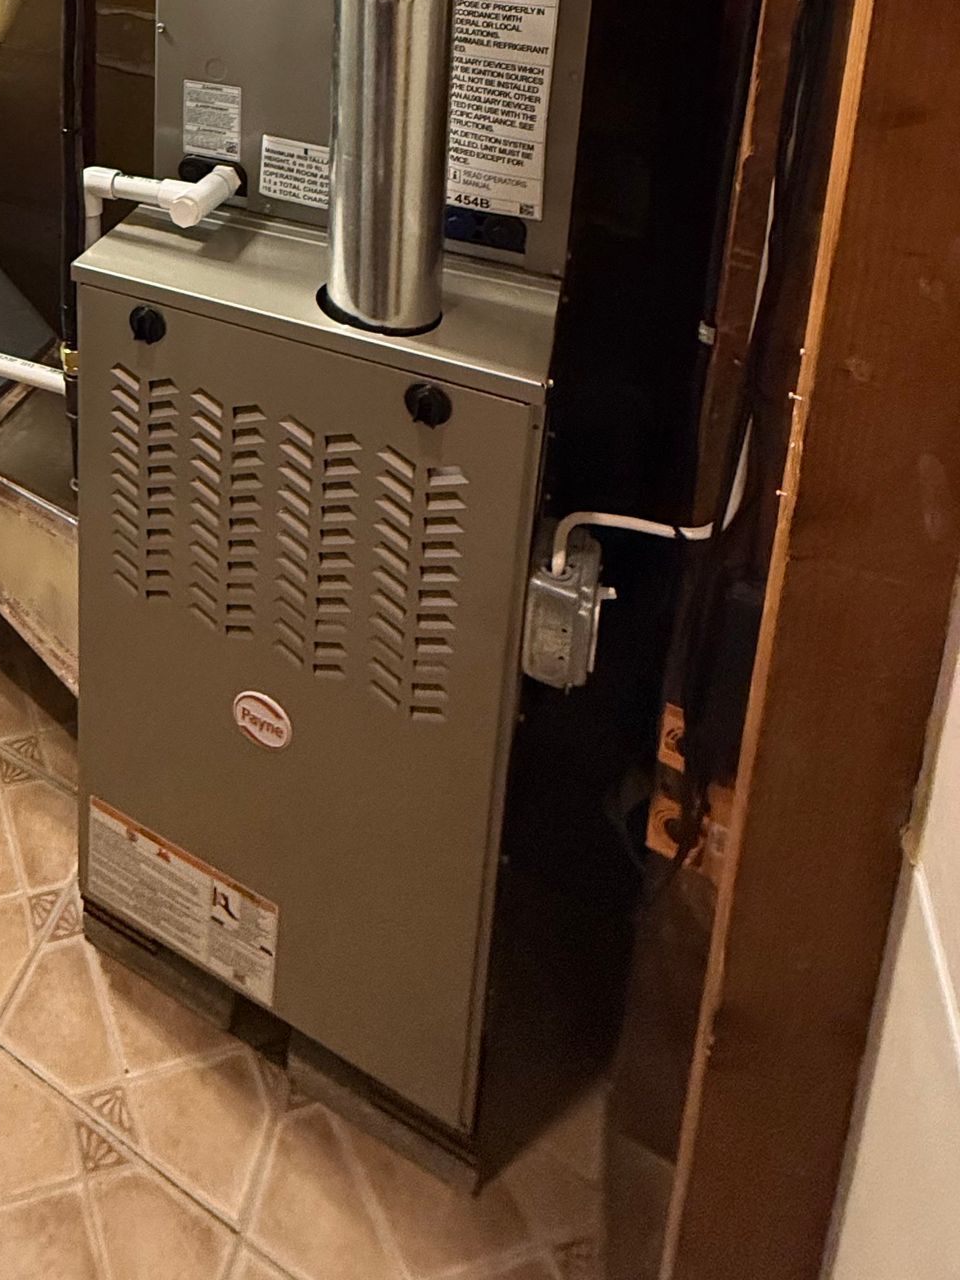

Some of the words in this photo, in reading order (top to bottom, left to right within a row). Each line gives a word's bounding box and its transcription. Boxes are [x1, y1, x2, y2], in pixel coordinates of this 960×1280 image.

[481, 2, 491, 10] OF
[493, 3, 535, 15] PROPERLY
[537, 8, 545, 16] IN
[502, 13, 523, 23] WITH
[482, 21, 494, 29] OR
[495, 22, 523, 32] LOCAL
[493, 40, 549, 55] REFRIGERANT
[483, 60, 517, 71] DEVICES
[517, 65, 545, 76] WHICH
[460, 66, 471, 74] BE
[472, 68, 504, 80] IGNITION
[505, 72, 544, 86] SOURCES
[468, 76, 484, 85] NOT
[485, 78, 496, 87] BE
[497, 81, 539, 94] INSTALLED
[463, 93, 501, 106] AUXILIARY
[502, 101, 536, 113] DEVICES
[513, 92, 542, 104] OTHER
[467, 102, 483, 111] FOR
[484, 105, 499, 114] USE
[500, 108, 521, 119] WITH
[522, 112, 537, 122] THE
[519, 121, 535, 131] SEE
[460, 130, 501, 144] DETECTION
[502, 140, 535, 151] SYSTEM
[265, 147, 295, 158] MINIMUM
[480, 143, 498, 153] UNIT
[498, 148, 520, 158] MUST
[521, 152, 534, 161] BE
[476, 153, 506, 164] EXCEPT
[507, 157, 524, 167] FOR
[264, 162, 294, 173] MINIMUM
[296, 168, 318, 178] ROOM
[463, 169, 483, 179] READ
[279, 181, 301, 191] TOTAL
[462, 180, 491, 191] MANUAL
[279, 189, 301, 199] TOTAL
[455, 194, 490, 209] 454B
[241, 706, 284, 739] Payne
